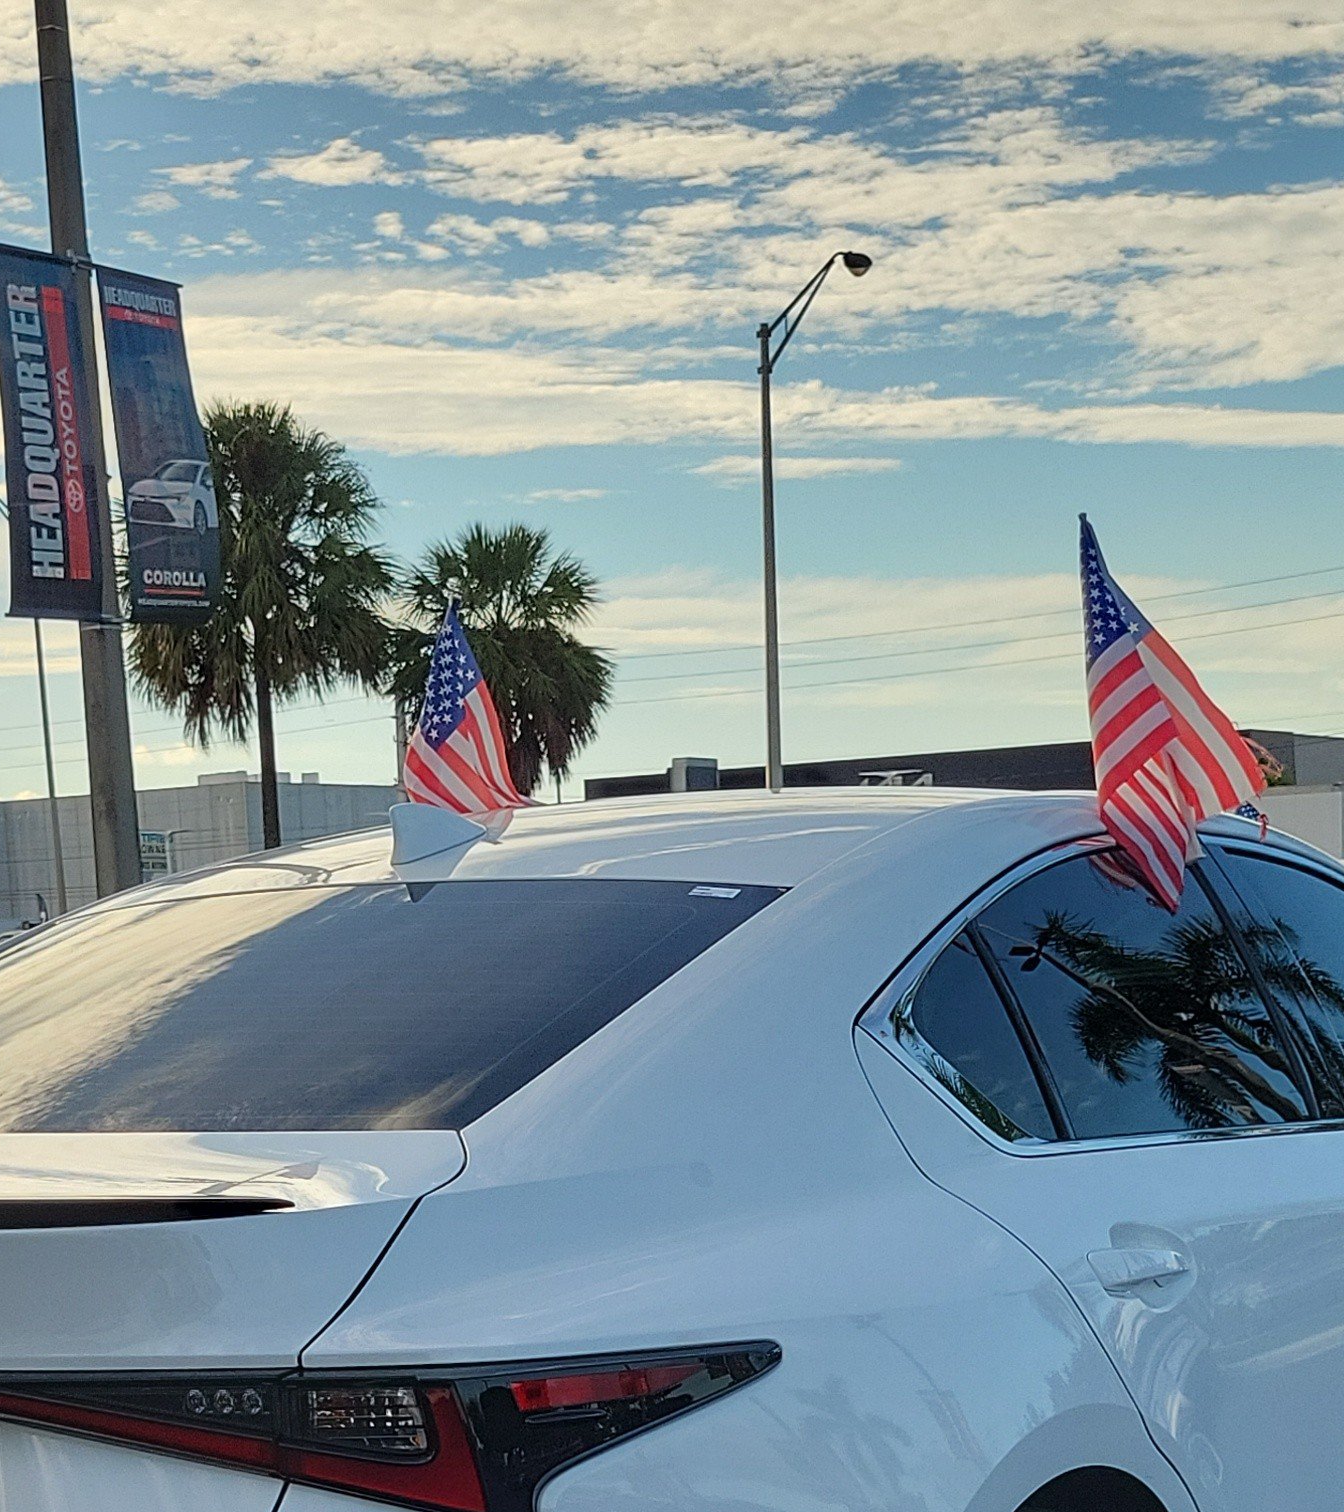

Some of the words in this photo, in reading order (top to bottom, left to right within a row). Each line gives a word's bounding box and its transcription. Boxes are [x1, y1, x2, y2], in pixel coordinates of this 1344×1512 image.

[103, 285, 177, 317] HEADQUARTER
[7, 284, 65, 579] HEADQUARTER
[55, 367, 81, 474] TOYOTA
[143, 569, 207, 587] COROLLA
